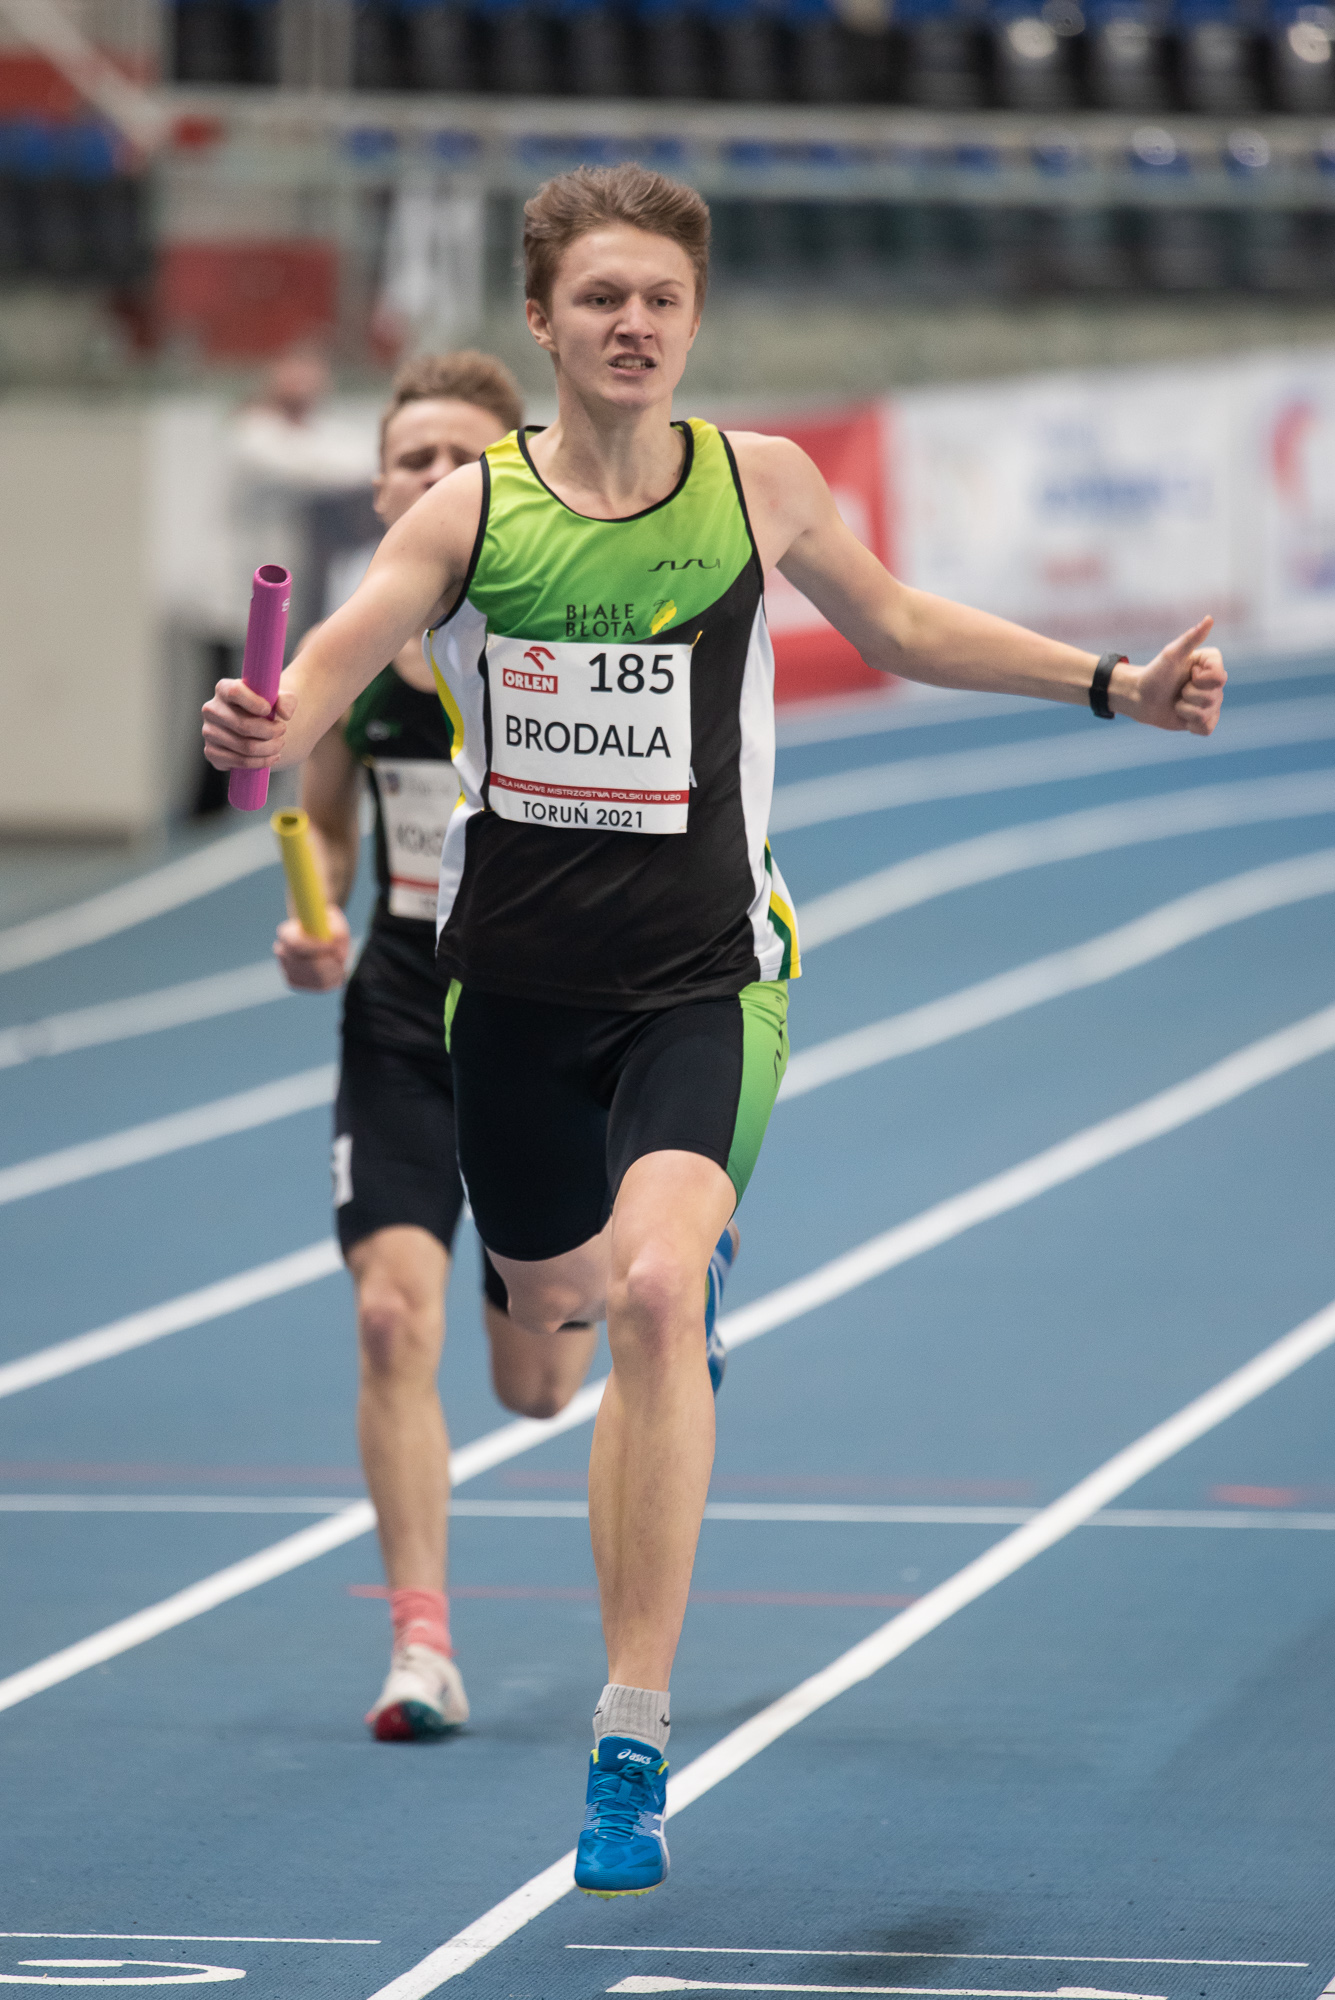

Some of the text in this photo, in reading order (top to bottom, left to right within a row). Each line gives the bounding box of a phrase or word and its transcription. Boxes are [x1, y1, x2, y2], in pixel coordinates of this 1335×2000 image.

[566, 603, 635, 620] BIAŁE
[565, 620, 636, 637] BŁOTA
[504, 671, 555, 692] ORLEN
[588, 652, 674, 695] 185
[505, 713, 671, 758] BRODALA
[514, 782, 545, 793] HALOWE
[547, 788, 610, 798] MISTRZOSTWA
[611, 792, 644, 800] POLSKI
[644, 793, 662, 801] U18
[663, 793, 681, 801] U20
[522, 800, 643, 829] TORUŃ 2021
